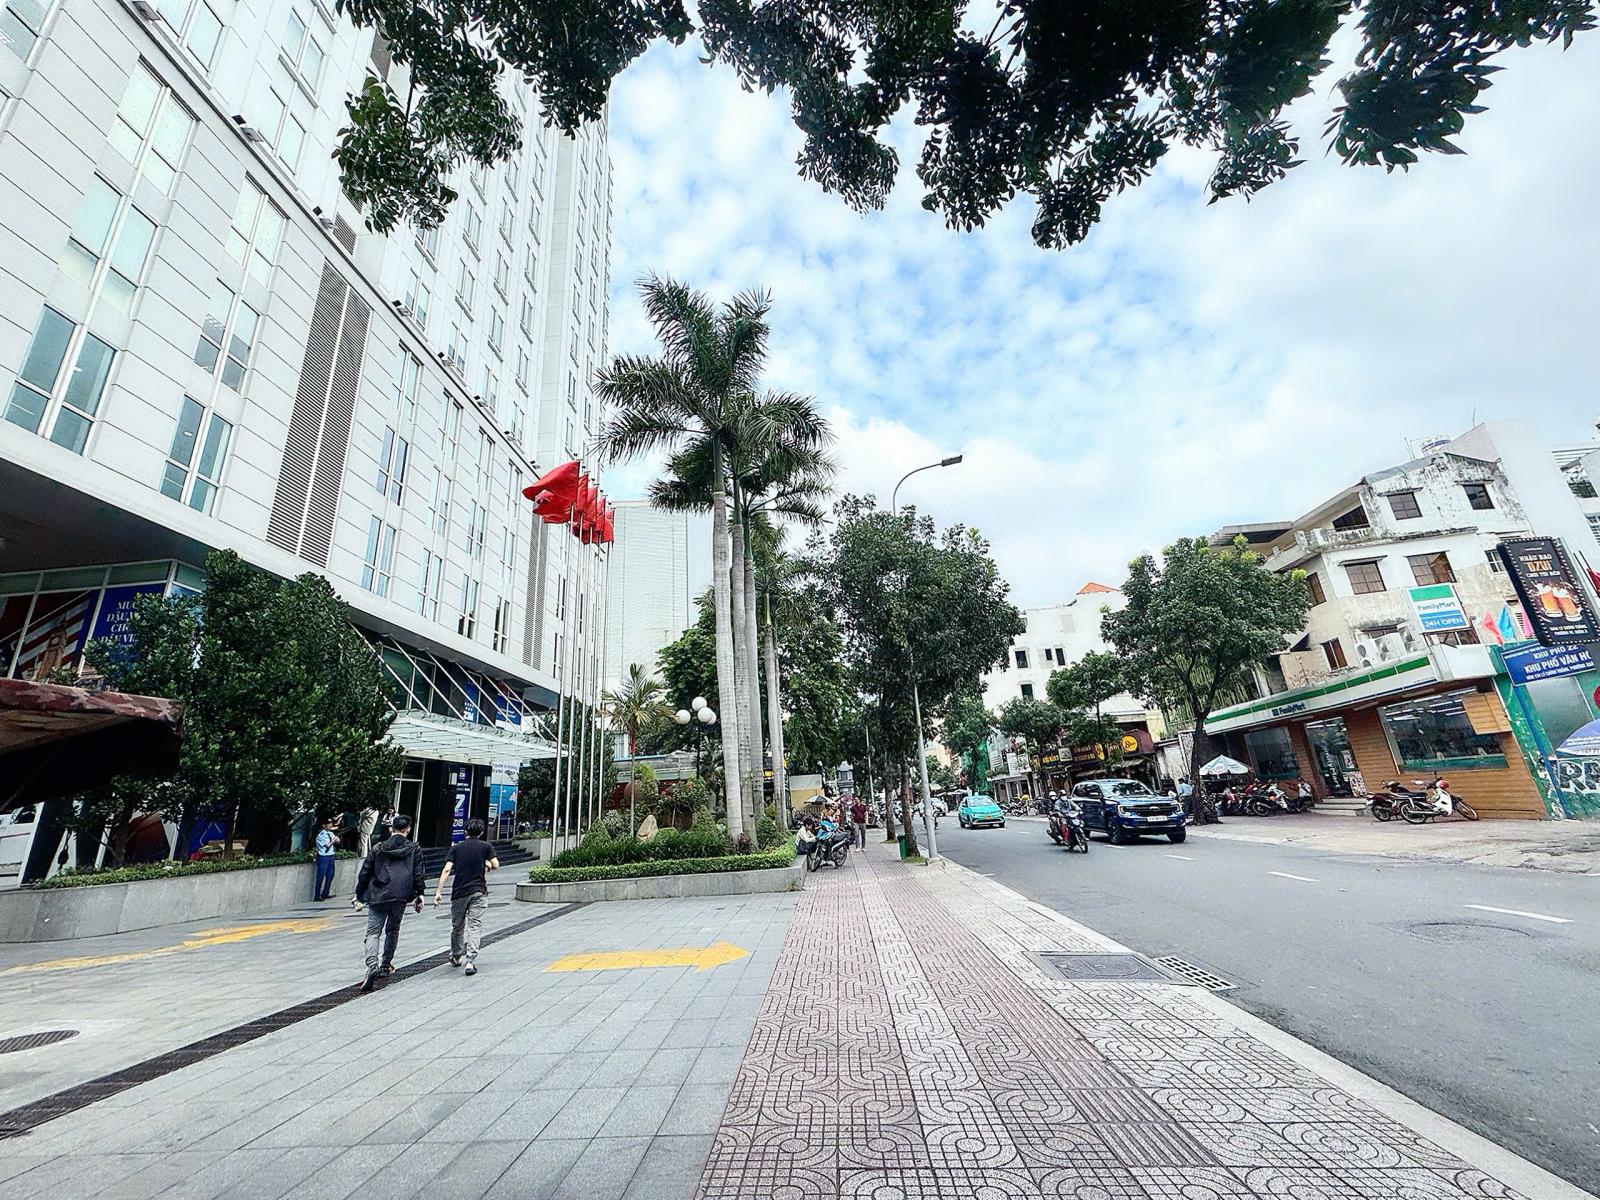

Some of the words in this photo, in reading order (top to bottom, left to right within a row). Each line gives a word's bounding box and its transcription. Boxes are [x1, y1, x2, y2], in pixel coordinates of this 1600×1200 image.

[1417, 602, 1456, 611] FamilyMart
[1441, 617, 1463, 626] OPEN
[1533, 650, 1549, 660] KHU
[1524, 664, 1541, 674] KHU
